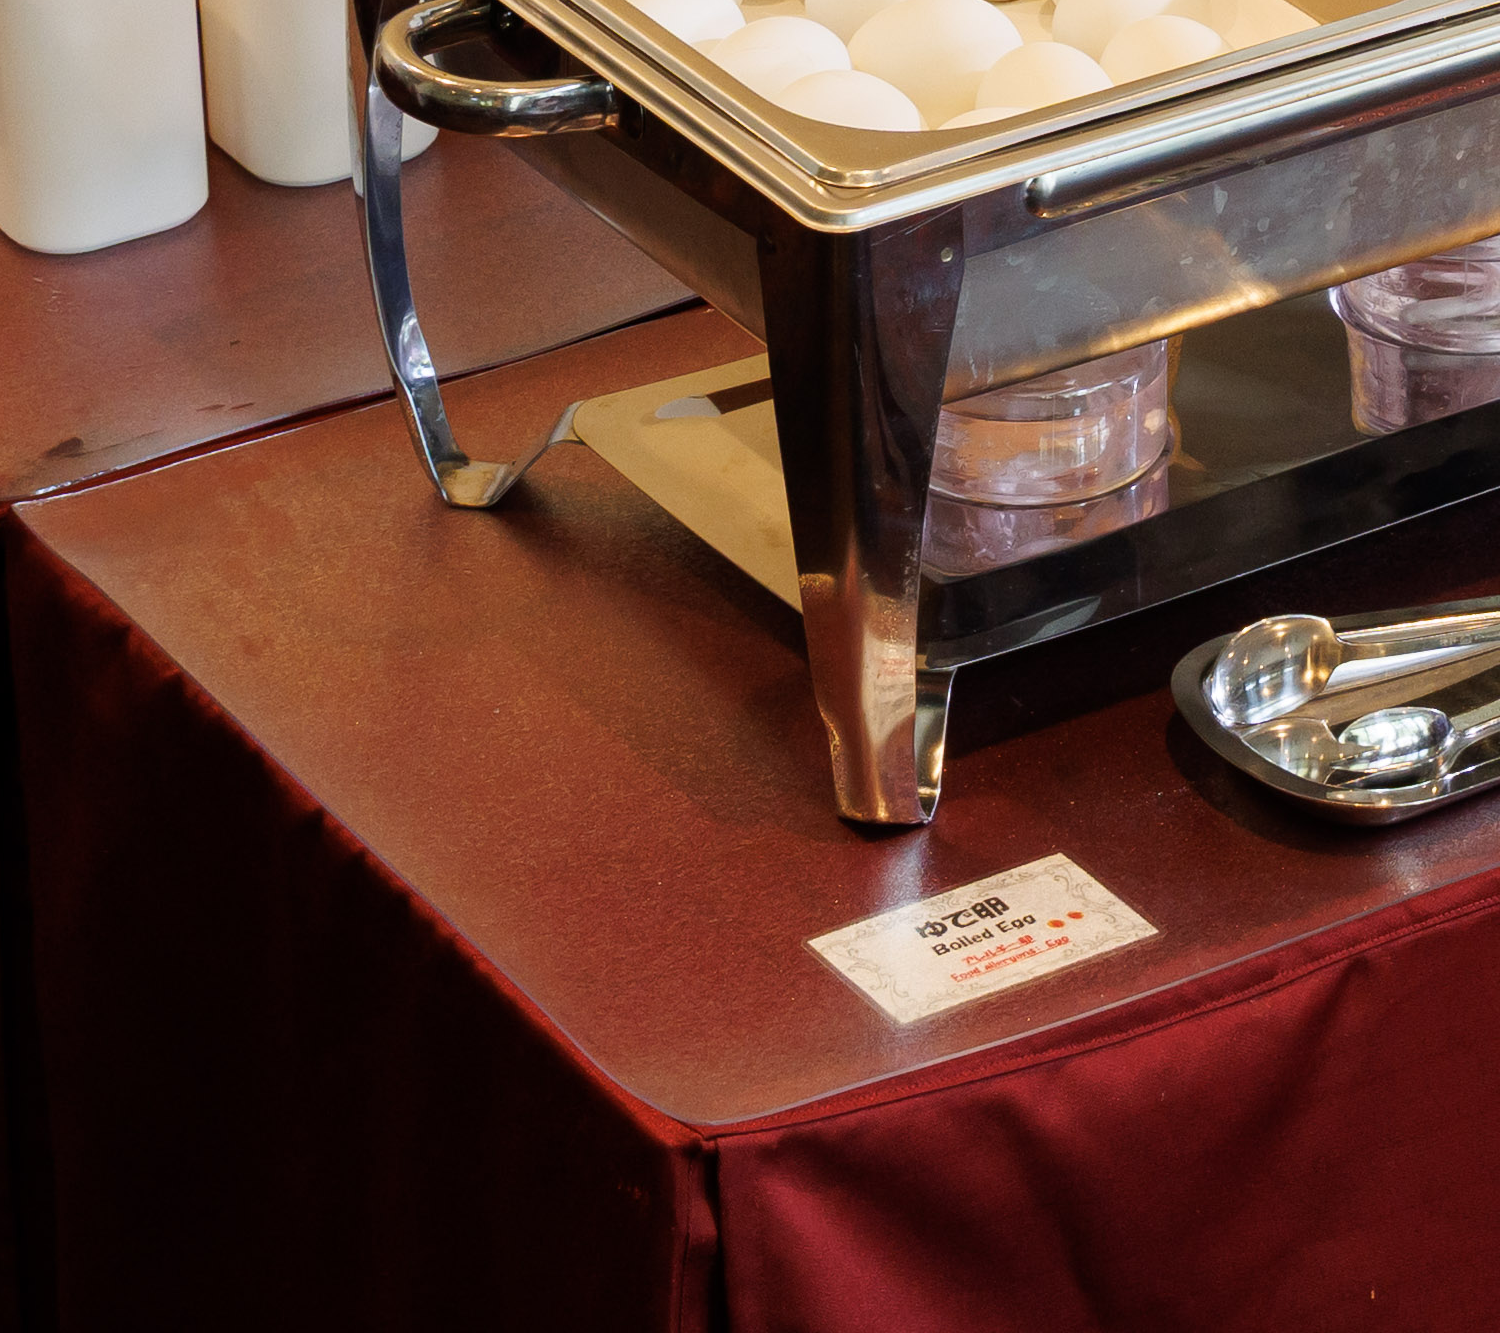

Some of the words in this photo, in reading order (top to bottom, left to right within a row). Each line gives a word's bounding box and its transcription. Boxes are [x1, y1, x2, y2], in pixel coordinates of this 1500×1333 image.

[914, 896, 1010, 939] ゆで卵
[931, 929, 994, 957] Boiled
[996, 913, 1037, 933] Egg
[950, 966, 981, 982] Food
[1044, 934, 1071, 949] Egg
